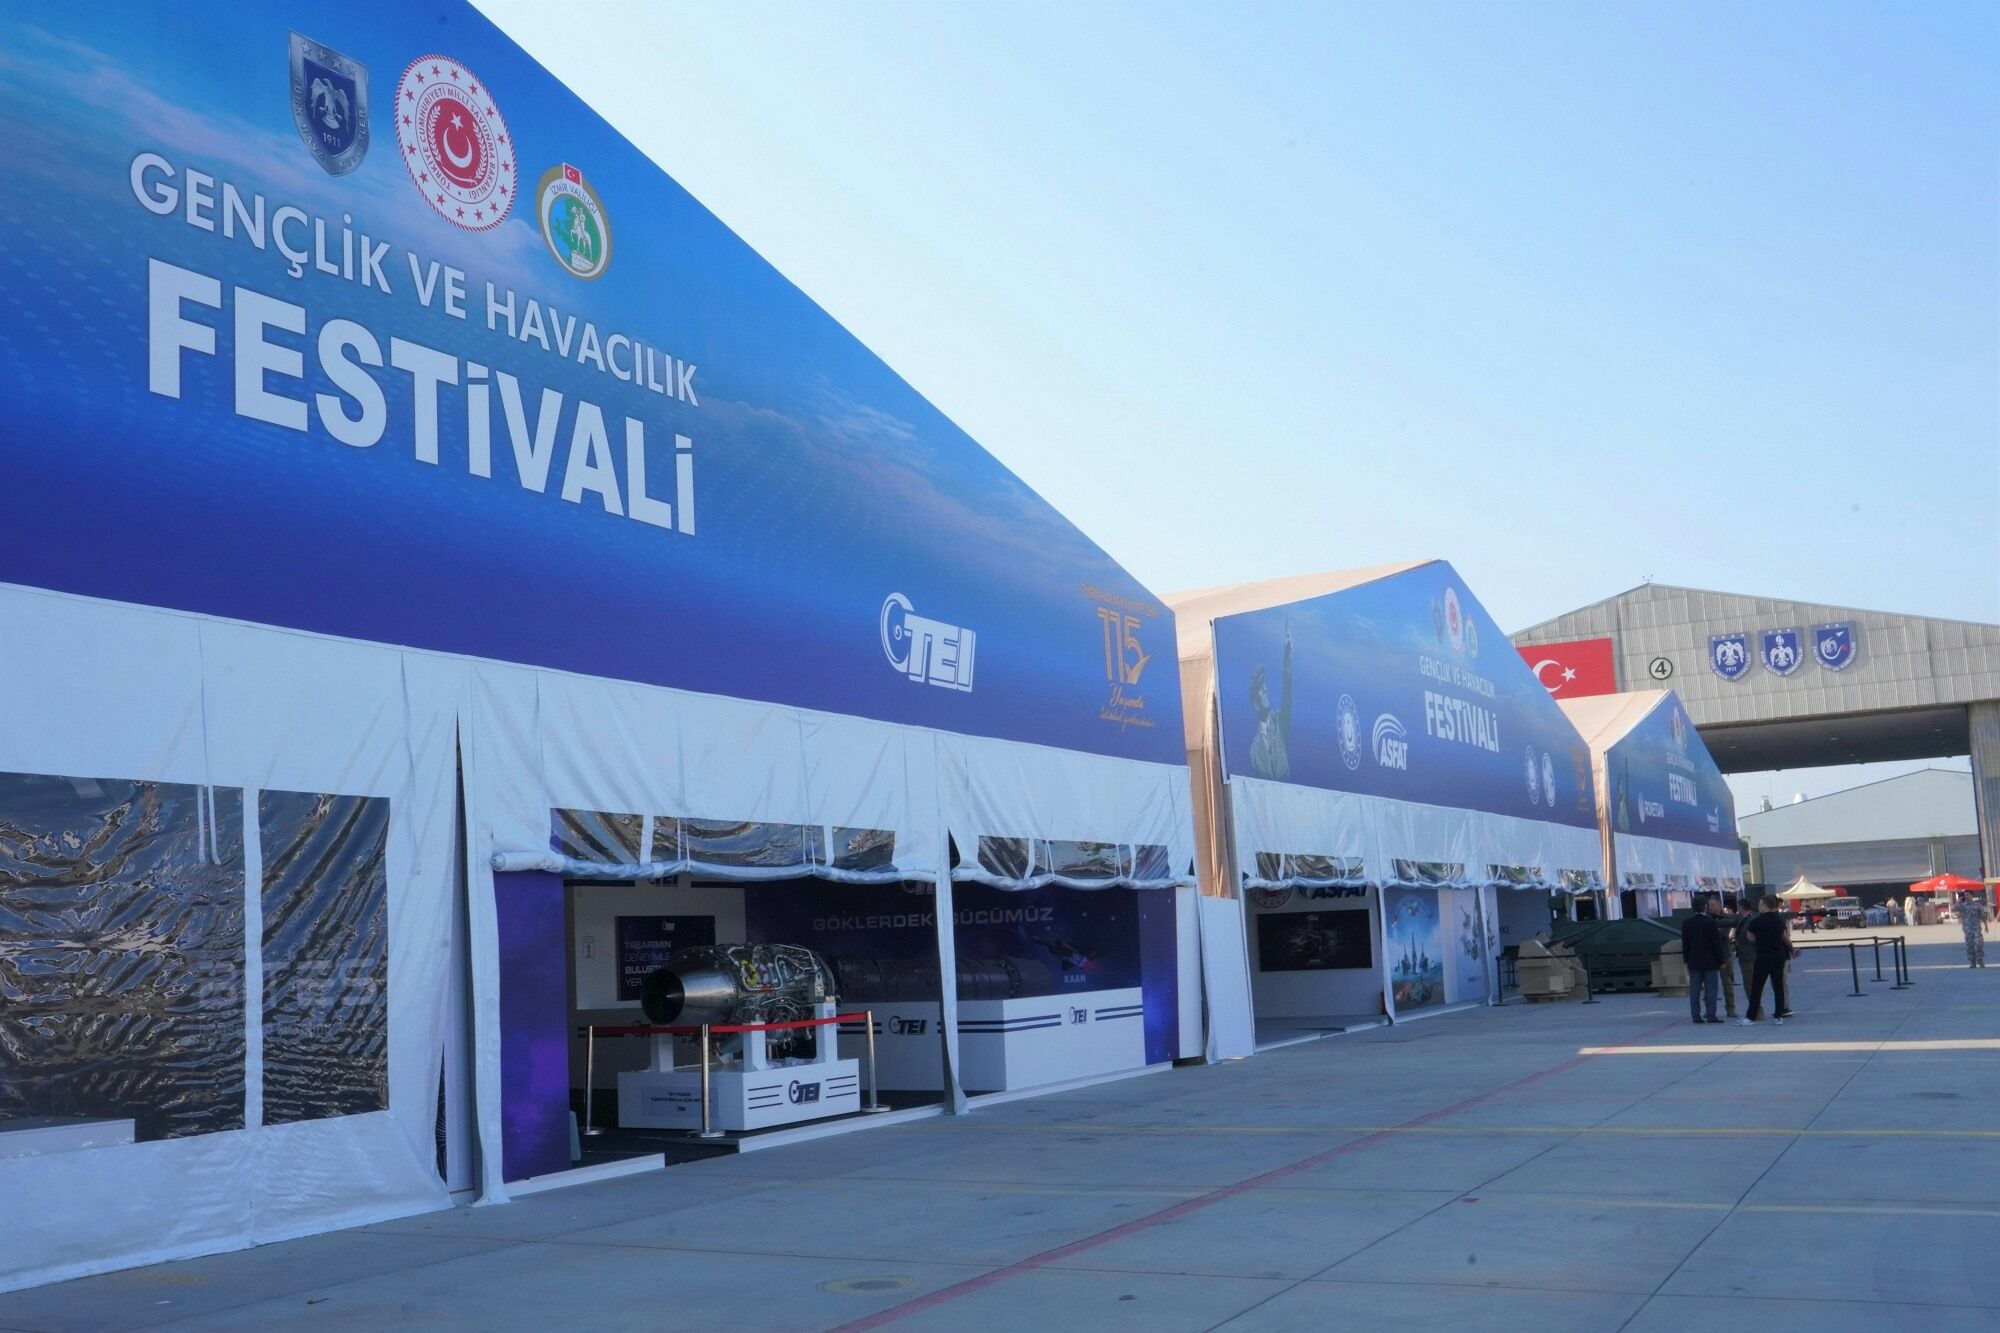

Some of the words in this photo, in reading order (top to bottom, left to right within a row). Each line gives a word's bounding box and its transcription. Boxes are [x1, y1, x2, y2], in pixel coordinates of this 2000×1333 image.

[322, 132, 341, 148] 1911
[130, 153, 392, 294] GENÇLİK
[408, 251, 467, 320] VE
[486, 281, 699, 406] HAVACILIK
[148, 258, 696, 537] FESTİVALİ
[1654, 661, 1667, 675] 4
[1424, 690, 1500, 753] FESTİVALİ
[1380, 737, 1408, 771] ASFAT
